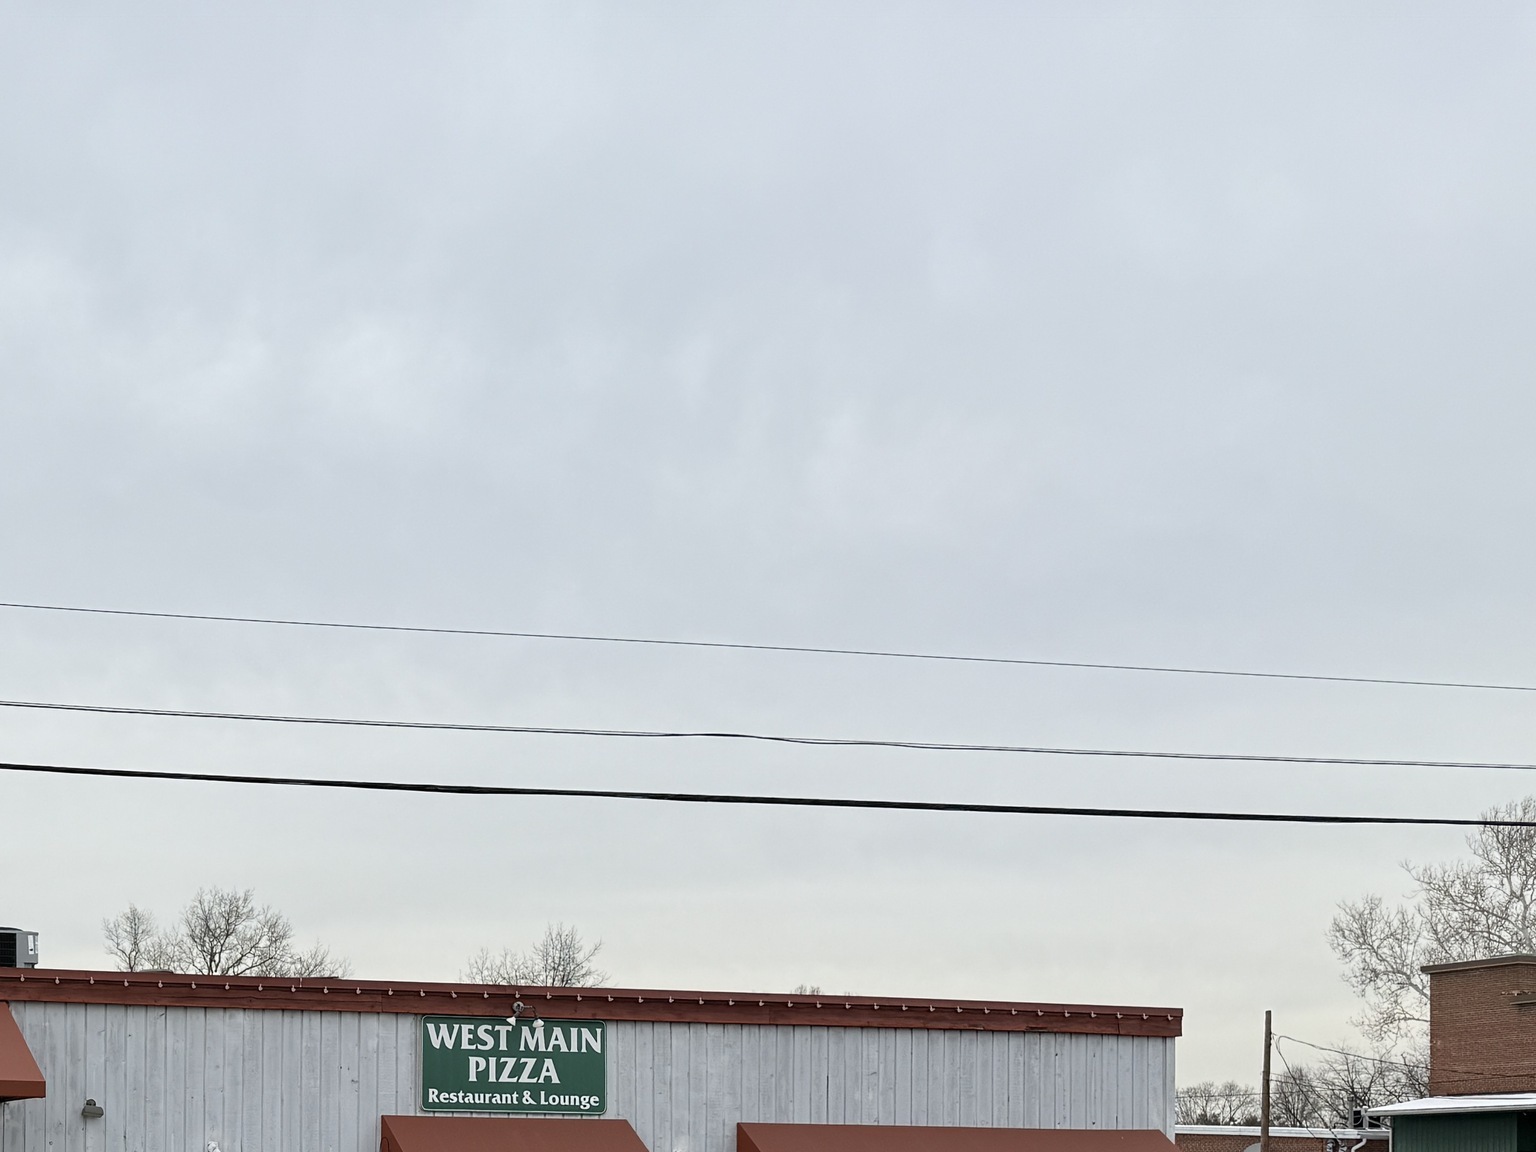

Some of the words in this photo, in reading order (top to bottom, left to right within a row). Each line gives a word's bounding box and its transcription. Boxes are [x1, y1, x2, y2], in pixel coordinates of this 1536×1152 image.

[426, 1023, 513, 1051] WEST
[519, 1025, 602, 1054] MAIN
[468, 1056, 561, 1084] PIZZA
[428, 1088, 519, 1105] Restaurant
[522, 1090, 537, 1105] &
[540, 1090, 600, 1110] Lounge
